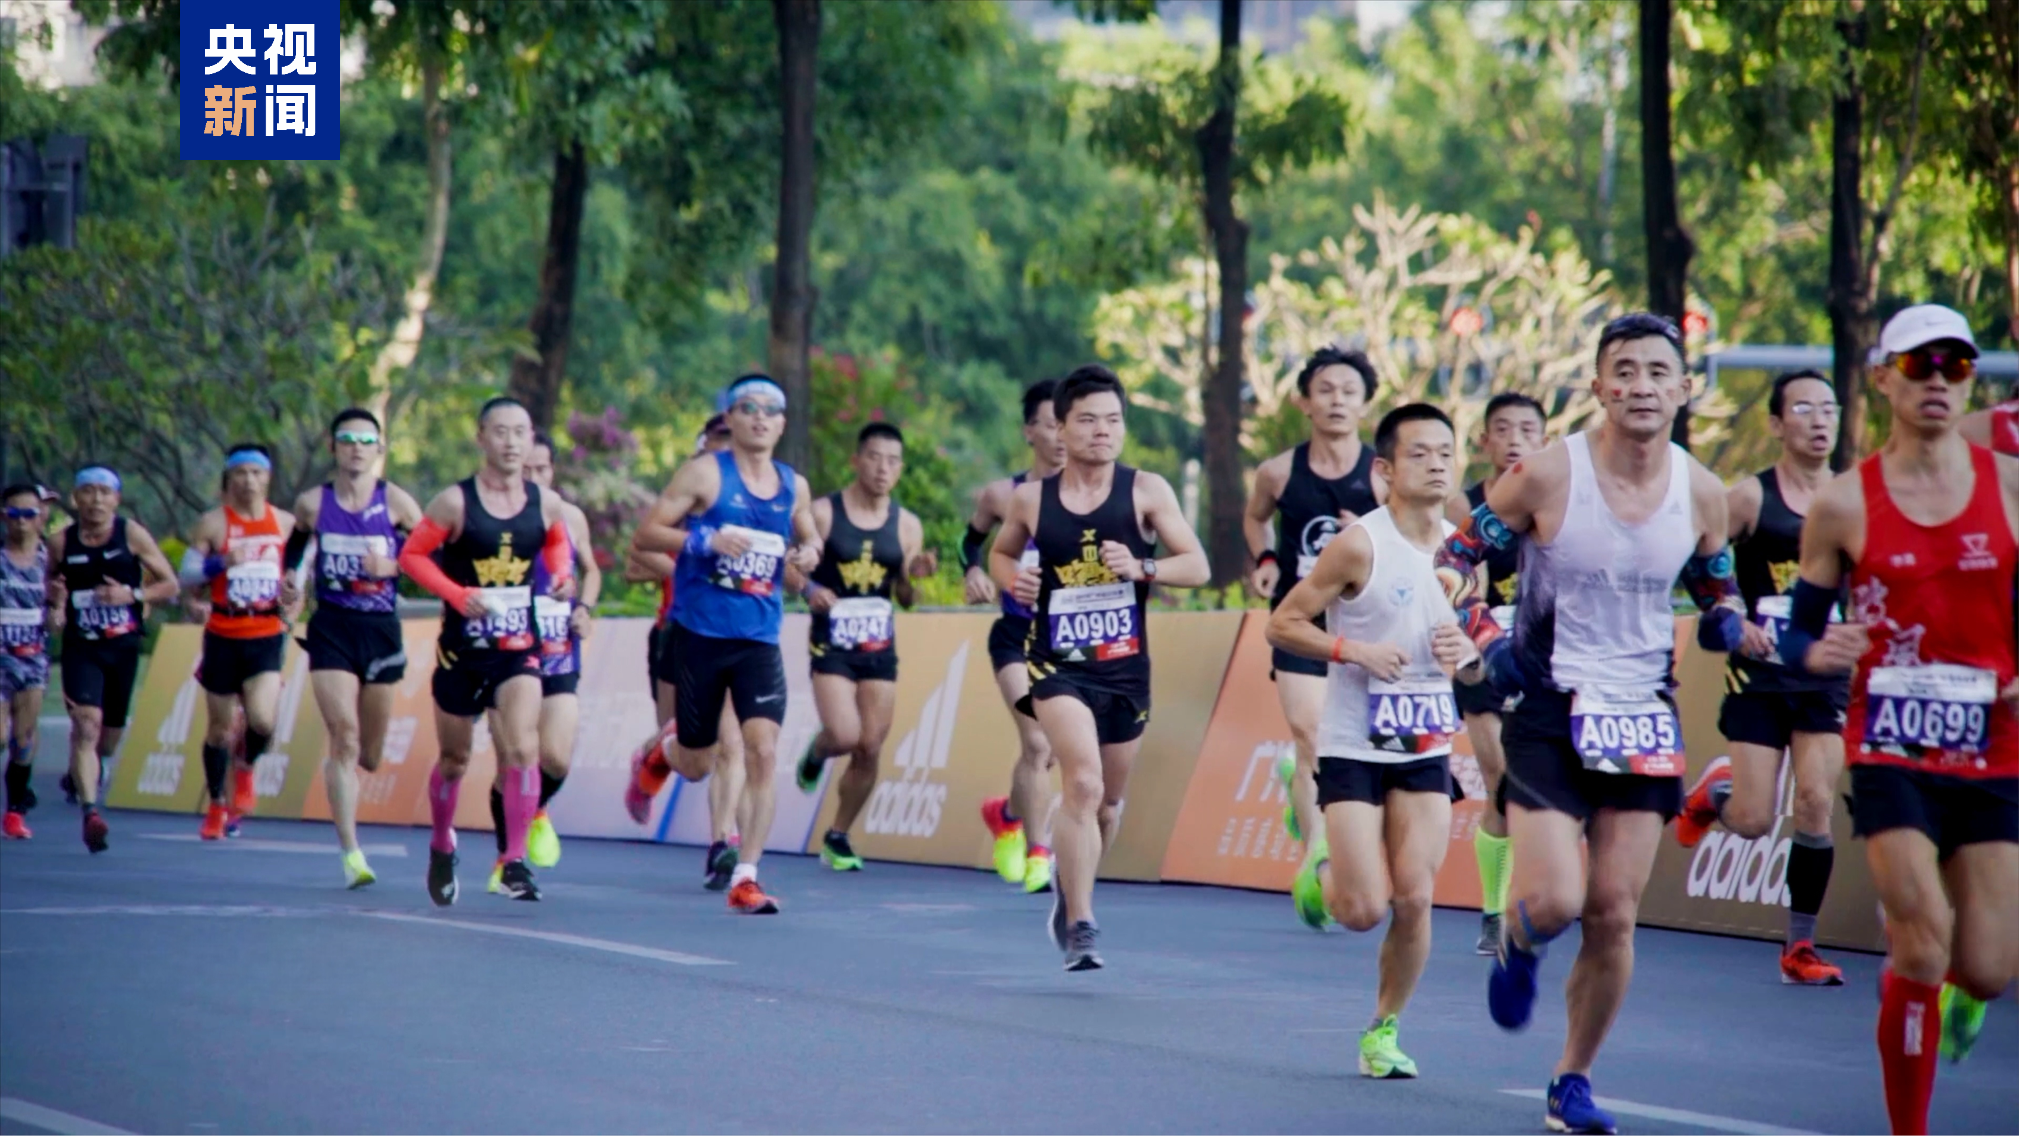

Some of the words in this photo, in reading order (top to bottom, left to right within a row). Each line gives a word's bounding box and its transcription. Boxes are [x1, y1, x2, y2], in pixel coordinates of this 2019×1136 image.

[1055, 607, 1133, 643] A0903
[1373, 694, 1455, 729] A0719
[1873, 697, 1986, 743] A0699
[1578, 715, 1676, 750] A0985
[863, 767, 947, 839] adidas
[1687, 815, 1793, 907] adida
